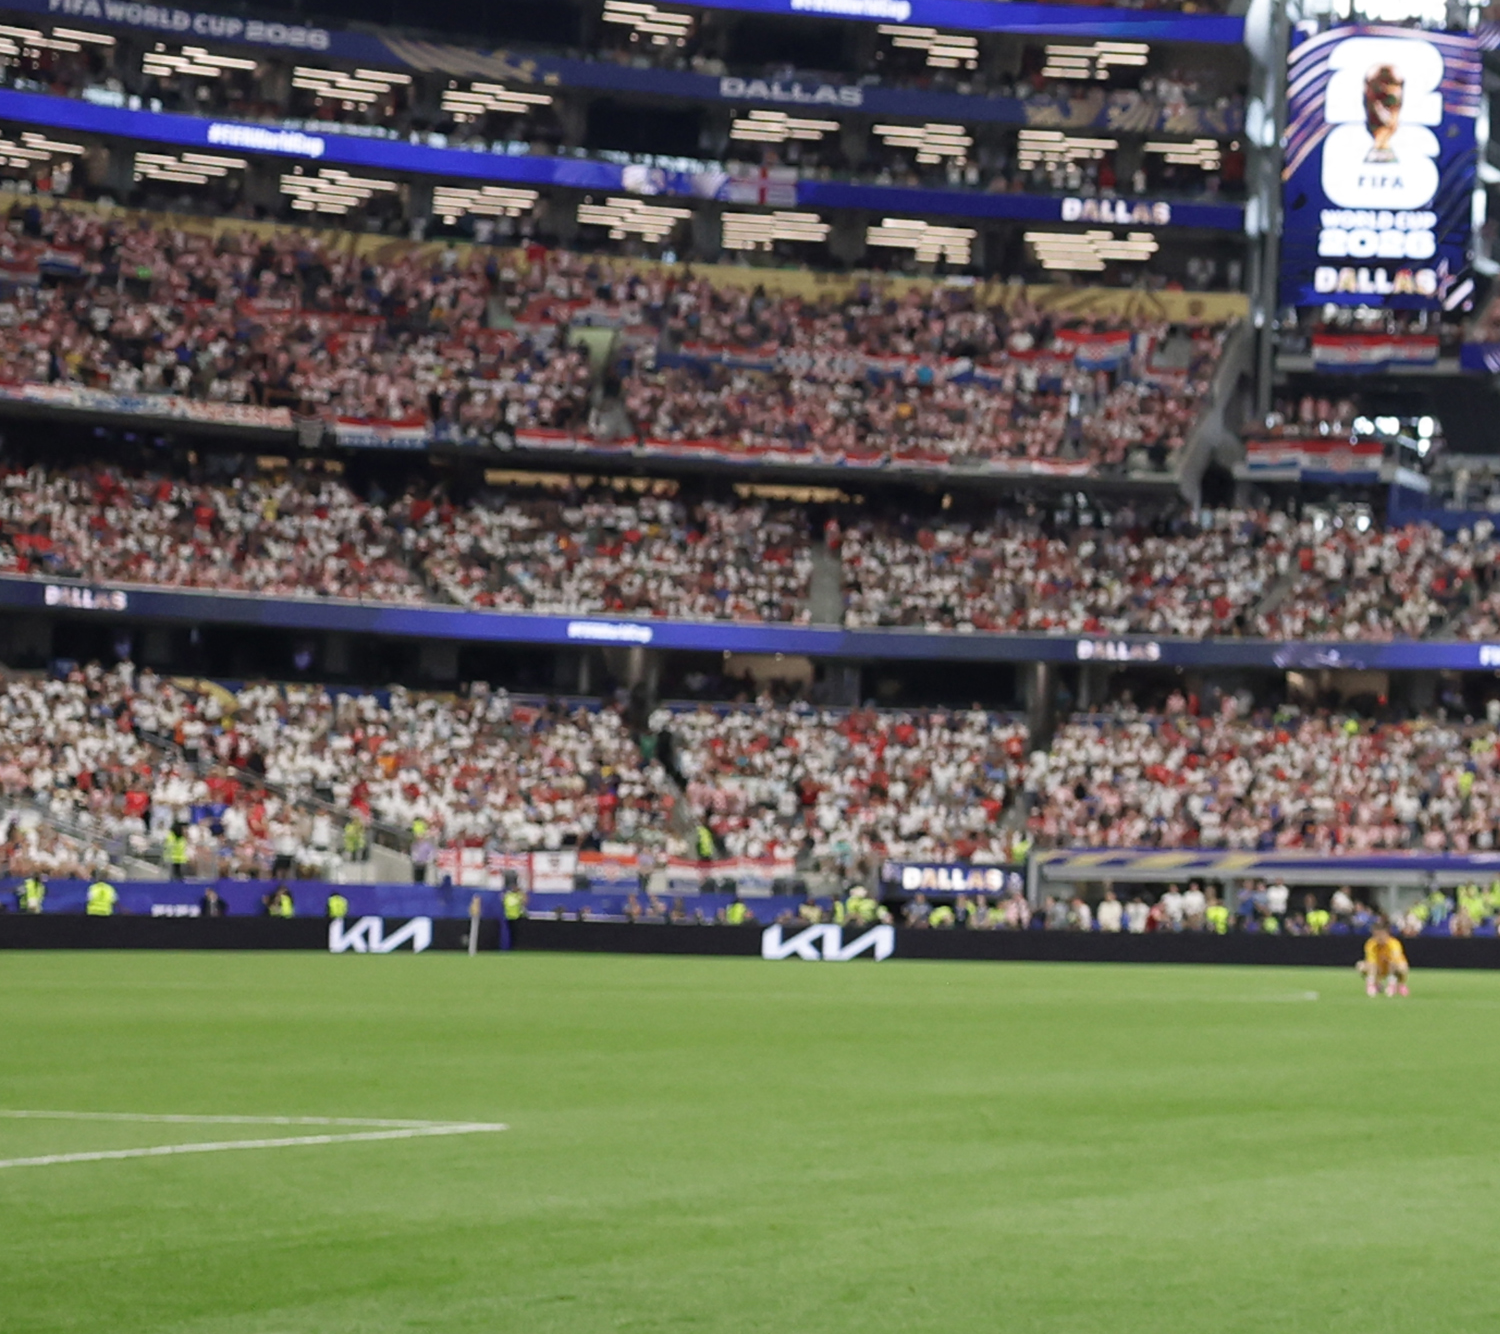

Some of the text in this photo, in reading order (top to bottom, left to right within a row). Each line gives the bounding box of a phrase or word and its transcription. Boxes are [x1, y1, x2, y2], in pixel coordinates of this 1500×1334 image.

[193, 12, 244, 37] CUP
[245, 19, 331, 51] 2026
[720, 76, 864, 107] DALLAS
[1357, 174, 1405, 188] FIFA
[1061, 196, 1172, 226] DALLAS
[1317, 229, 1437, 259] 2026
[1313, 265, 1437, 295] DALLAS
[902, 866, 1004, 892] DALLAS
[329, 916, 433, 954] KIA
[762, 923, 896, 961] KIA
